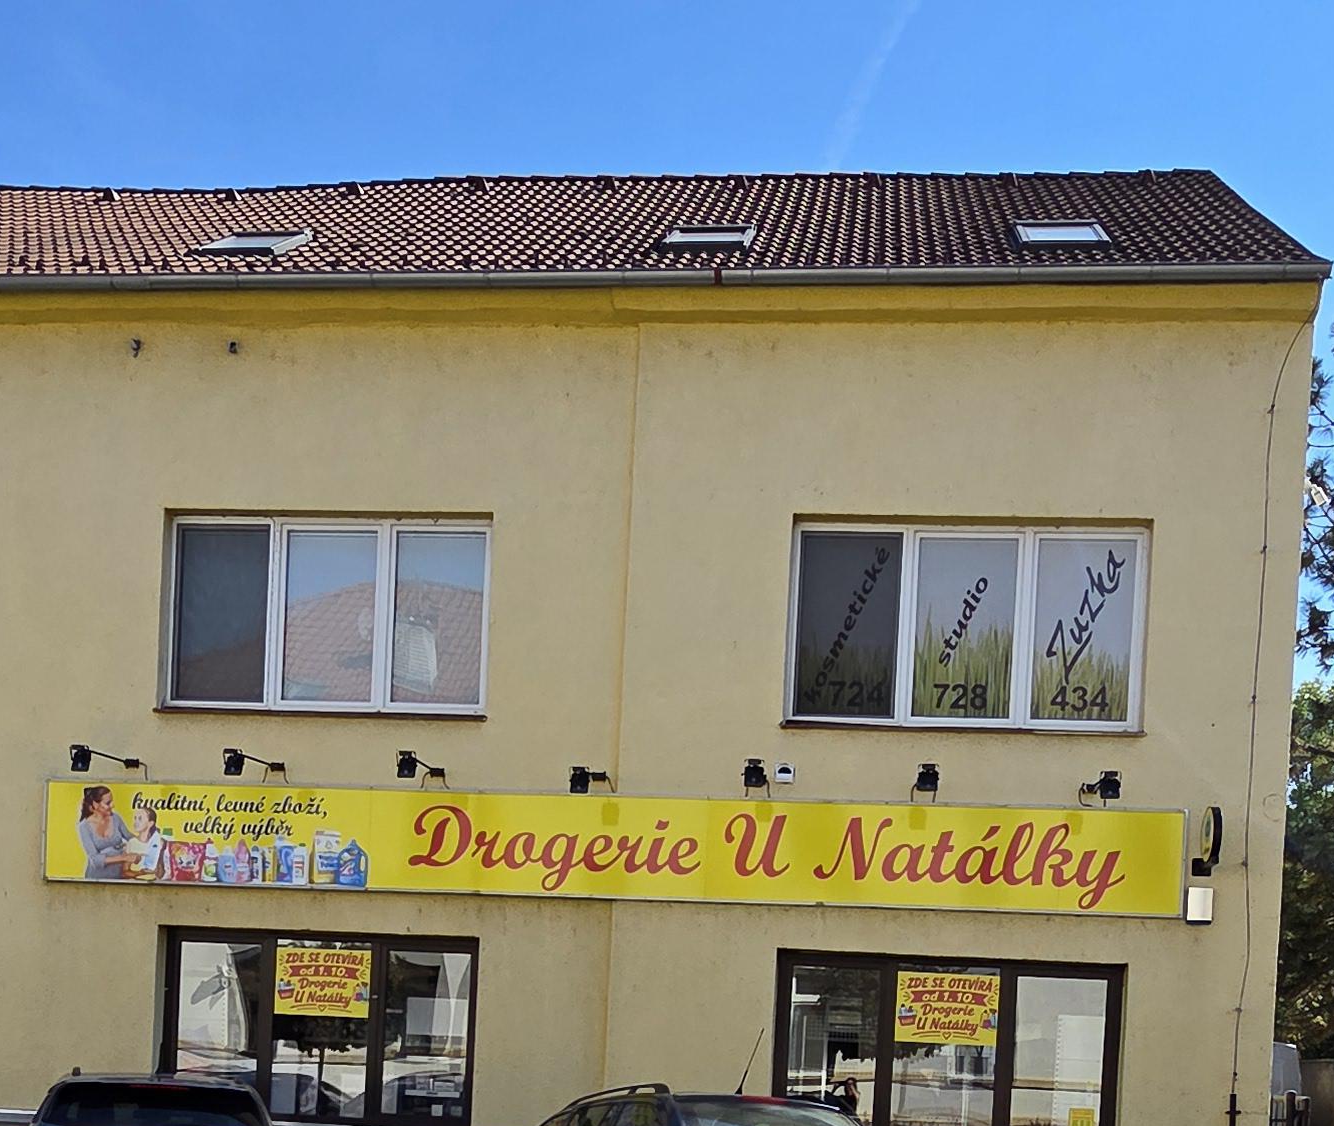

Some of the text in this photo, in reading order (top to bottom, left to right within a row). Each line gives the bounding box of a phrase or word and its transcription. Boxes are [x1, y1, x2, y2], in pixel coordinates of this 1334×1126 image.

[939, 576, 989, 668] studio
[1046, 549, 1126, 685] Zuzka
[933, 683, 987, 711] 728
[1050, 684, 1109, 713] 434
[131, 793, 329, 818] kvalitní, levné zboží,
[183, 816, 294, 842] velký výběr
[408, 805, 1127, 910] Drogerie U Natálky
[285, 951, 365, 966] ZDE SE OTEVÍRÁ
[299, 966, 314, 976] od
[298, 979, 348, 992] Drogerie
[907, 976, 993, 991] ZDE SE OTEVÍRÁ
[295, 990, 353, 1009] U Natálky
[922, 991, 939, 1002] od
[921, 1004, 975, 1017] Drogerie
[917, 1017, 979, 1036] U Natálky
